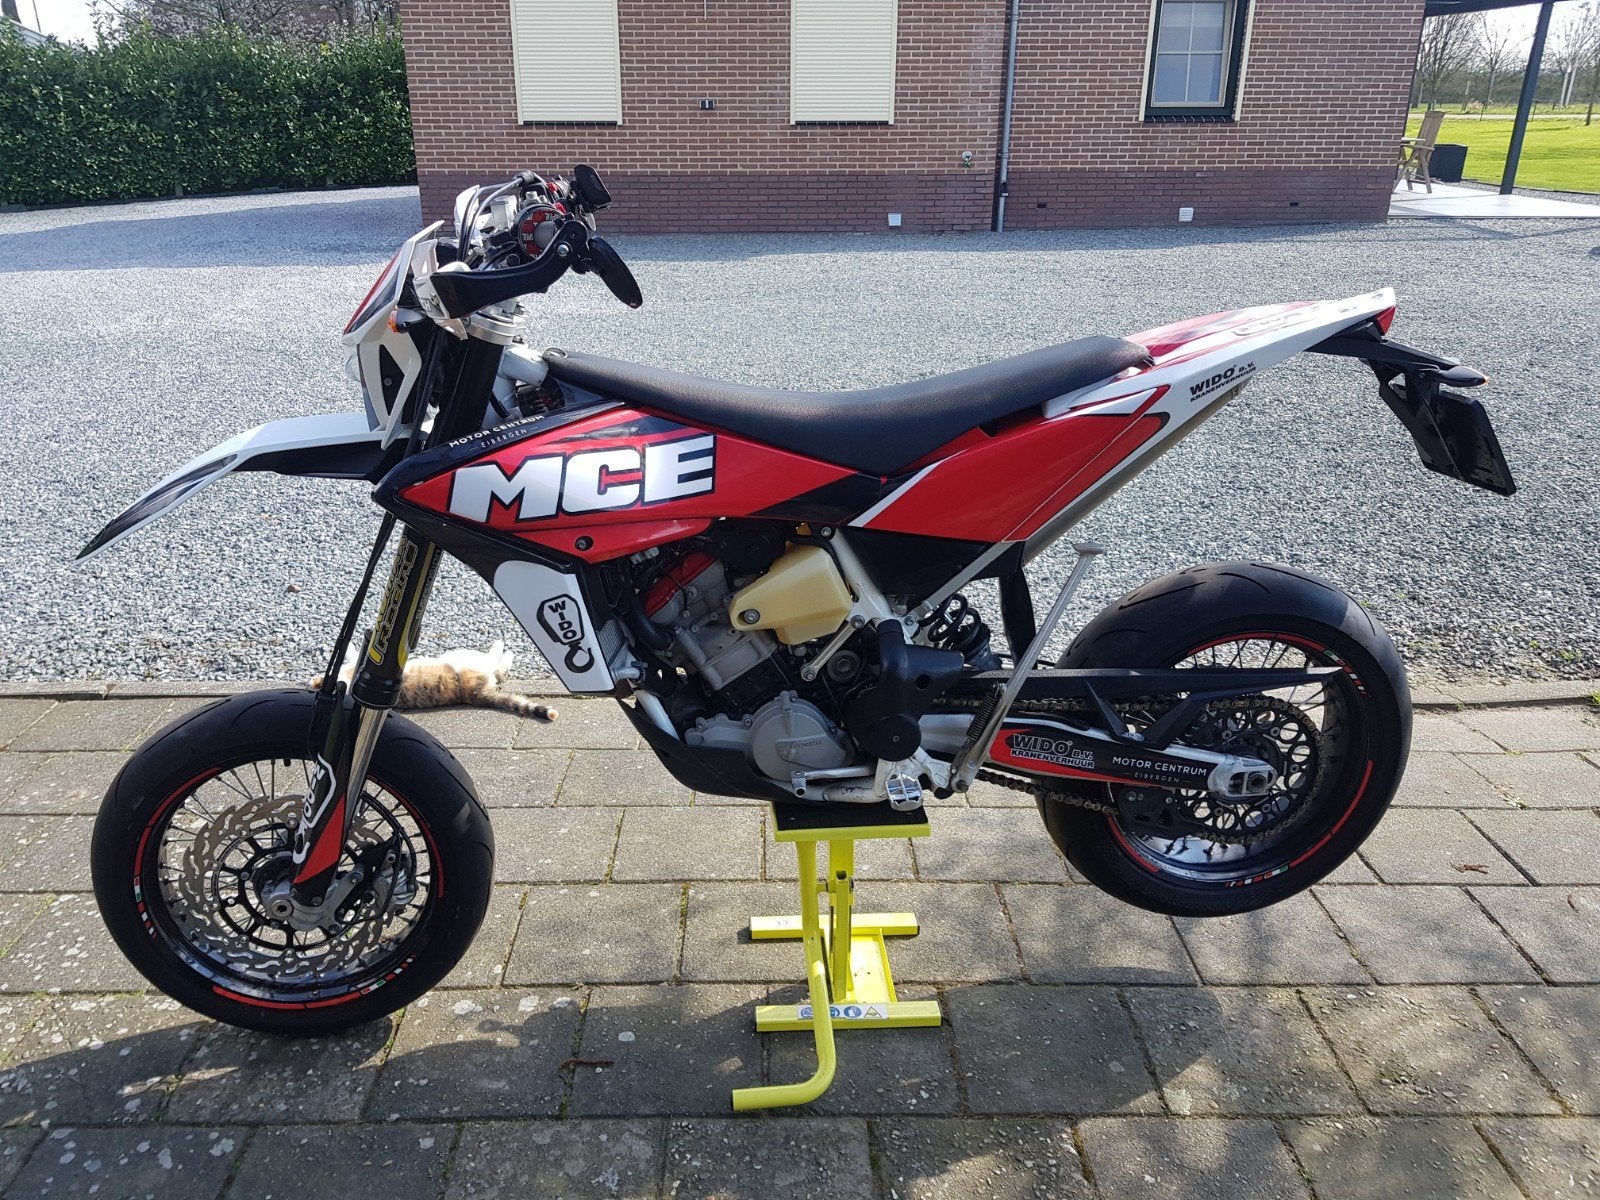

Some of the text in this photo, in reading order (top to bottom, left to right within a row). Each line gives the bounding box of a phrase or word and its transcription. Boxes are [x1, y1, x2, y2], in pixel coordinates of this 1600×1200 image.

[1189, 366, 1236, 396] WIDO
[1190, 366, 1257, 403] KRANENVERHUUR
[449, 415, 545, 448] MOTOR CENTRUM
[481, 429, 527, 448] EIBERGEN
[448, 433, 715, 523] MCE
[547, 600, 577, 640] WIDO
[1010, 748, 1095, 769] KRANENVERHUUR
[1013, 733, 1093, 761] WIDO B.V.
[1112, 756, 1207, 776] MOTOR CENTRUM
[1134, 771, 1180, 783] EIBERGEN
